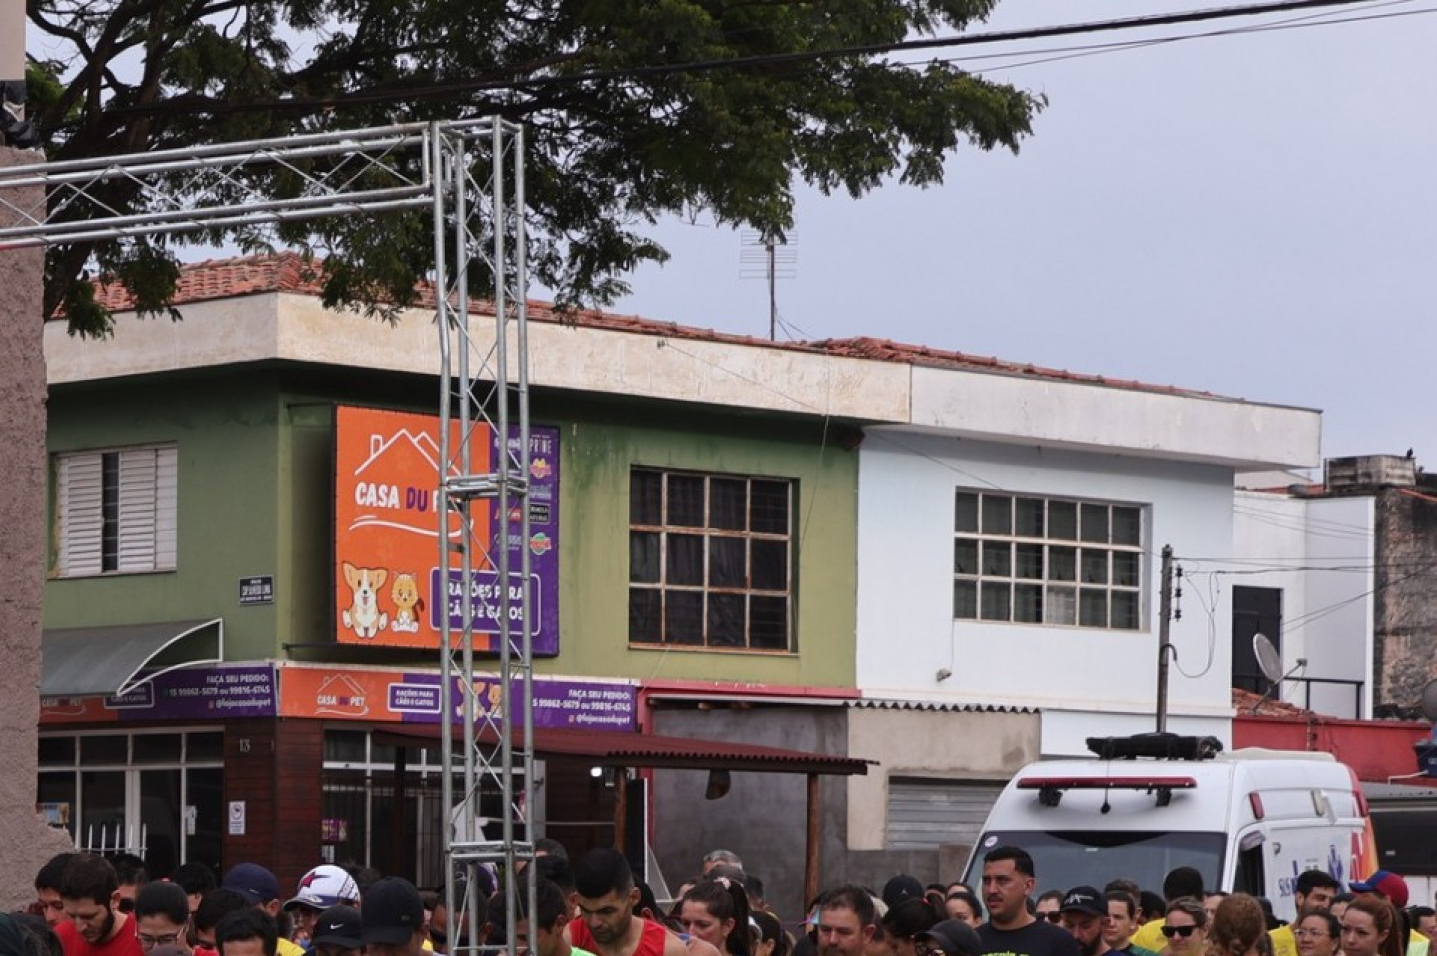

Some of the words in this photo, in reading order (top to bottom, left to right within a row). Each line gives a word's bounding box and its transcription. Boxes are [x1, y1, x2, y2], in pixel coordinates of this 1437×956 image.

[354, 482, 400, 510] CASA
[406, 487, 428, 512] DU
[448, 581, 492, 598] RAÕES
[317, 695, 337, 705] CASA
[350, 696, 365, 706] PET
